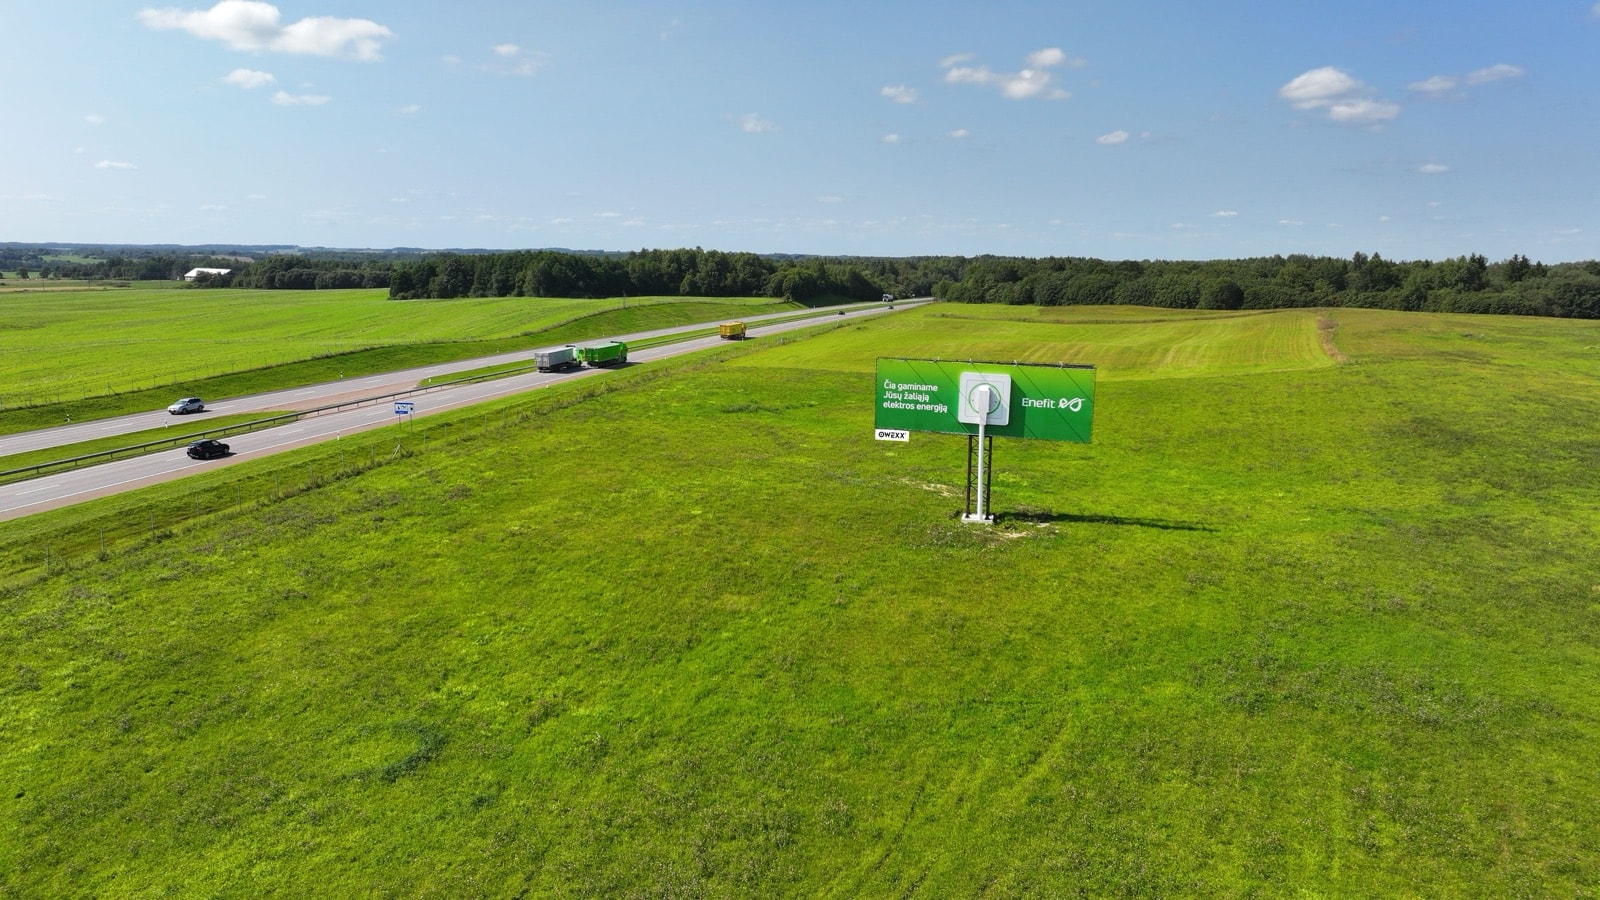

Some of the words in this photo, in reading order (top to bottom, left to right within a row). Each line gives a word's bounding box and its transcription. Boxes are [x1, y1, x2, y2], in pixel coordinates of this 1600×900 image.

[884, 379, 896, 389] Čia
[898, 383, 938, 392] gaminame
[883, 391, 902, 401] Jūsų
[904, 392, 930, 402] žaliąją
[883, 400, 915, 410] elektros
[916, 403, 948, 414] energiją
[1022, 398, 1056, 408] Enefit
[878, 431, 905, 439] OWEXX
